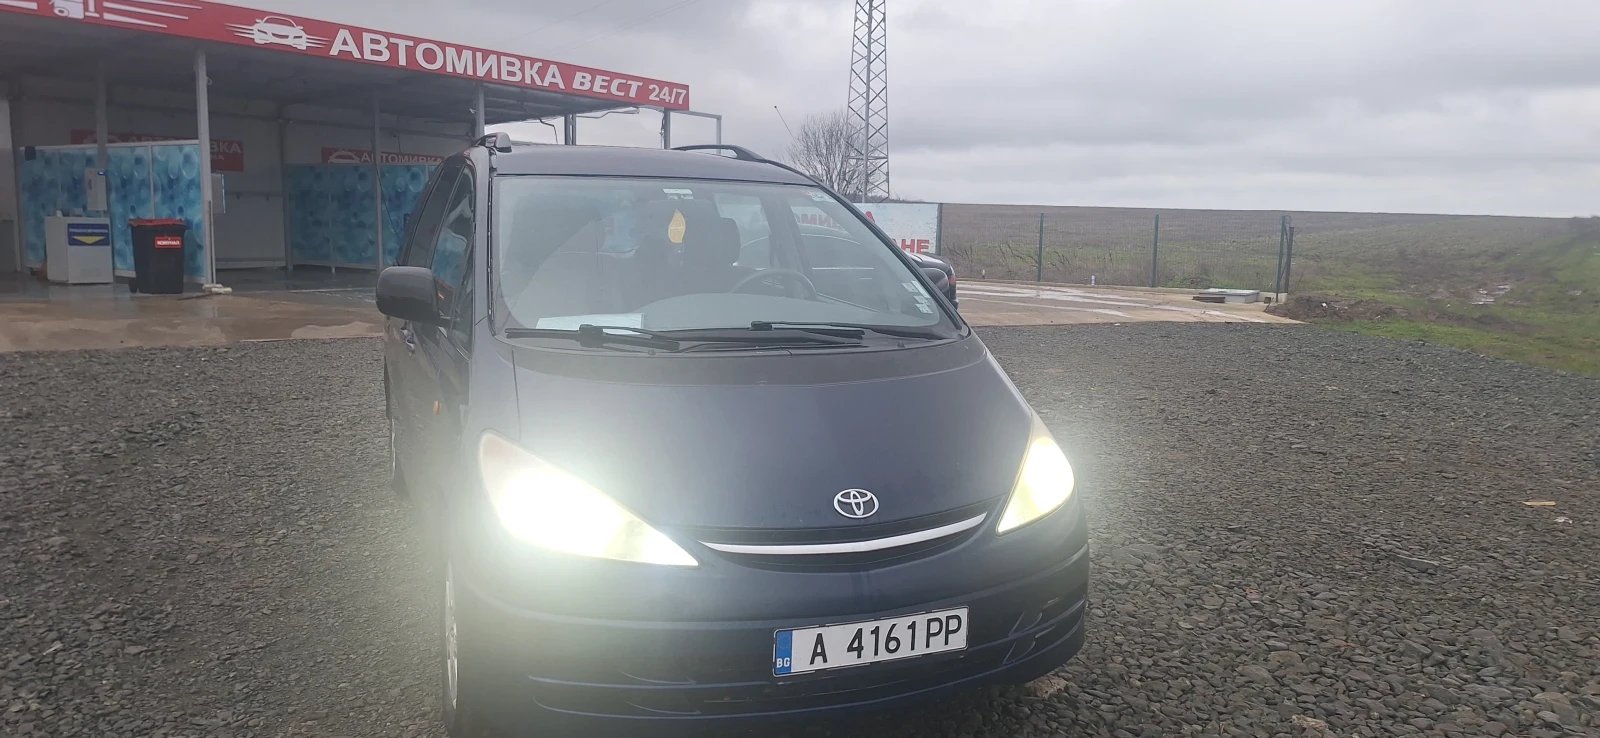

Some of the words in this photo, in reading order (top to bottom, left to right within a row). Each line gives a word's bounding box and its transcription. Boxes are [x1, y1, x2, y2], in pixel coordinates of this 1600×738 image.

[329, 28, 566, 90] АВТОМИВКА
[572, 70, 643, 98] ВЕСТ
[648, 84, 687, 105] 24/7
[776, 657, 791, 668] BG
[809, 632, 828, 665] A
